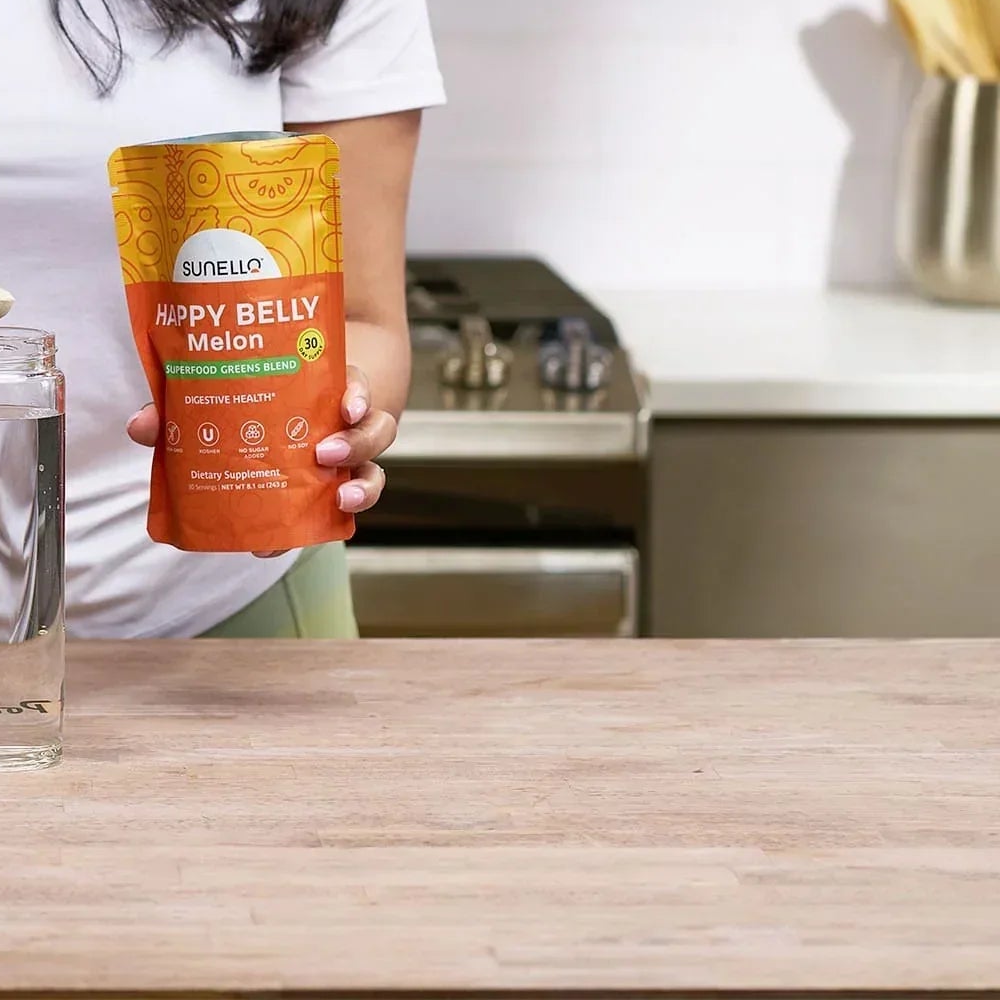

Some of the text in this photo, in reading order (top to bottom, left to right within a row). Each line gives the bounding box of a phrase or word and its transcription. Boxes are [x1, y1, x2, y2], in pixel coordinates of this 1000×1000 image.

[182, 258, 262, 277] SUNELLO
[155, 296, 319, 328] HAPPY BELLY
[187, 331, 264, 351] Melon
[304, 337, 318, 350] 30
[165, 360, 297, 375] SUPERFOOD GREENS BLEND
[184, 395, 231, 405] DIGESTIVE
[191, 468, 281, 482] Dietary Supplement
